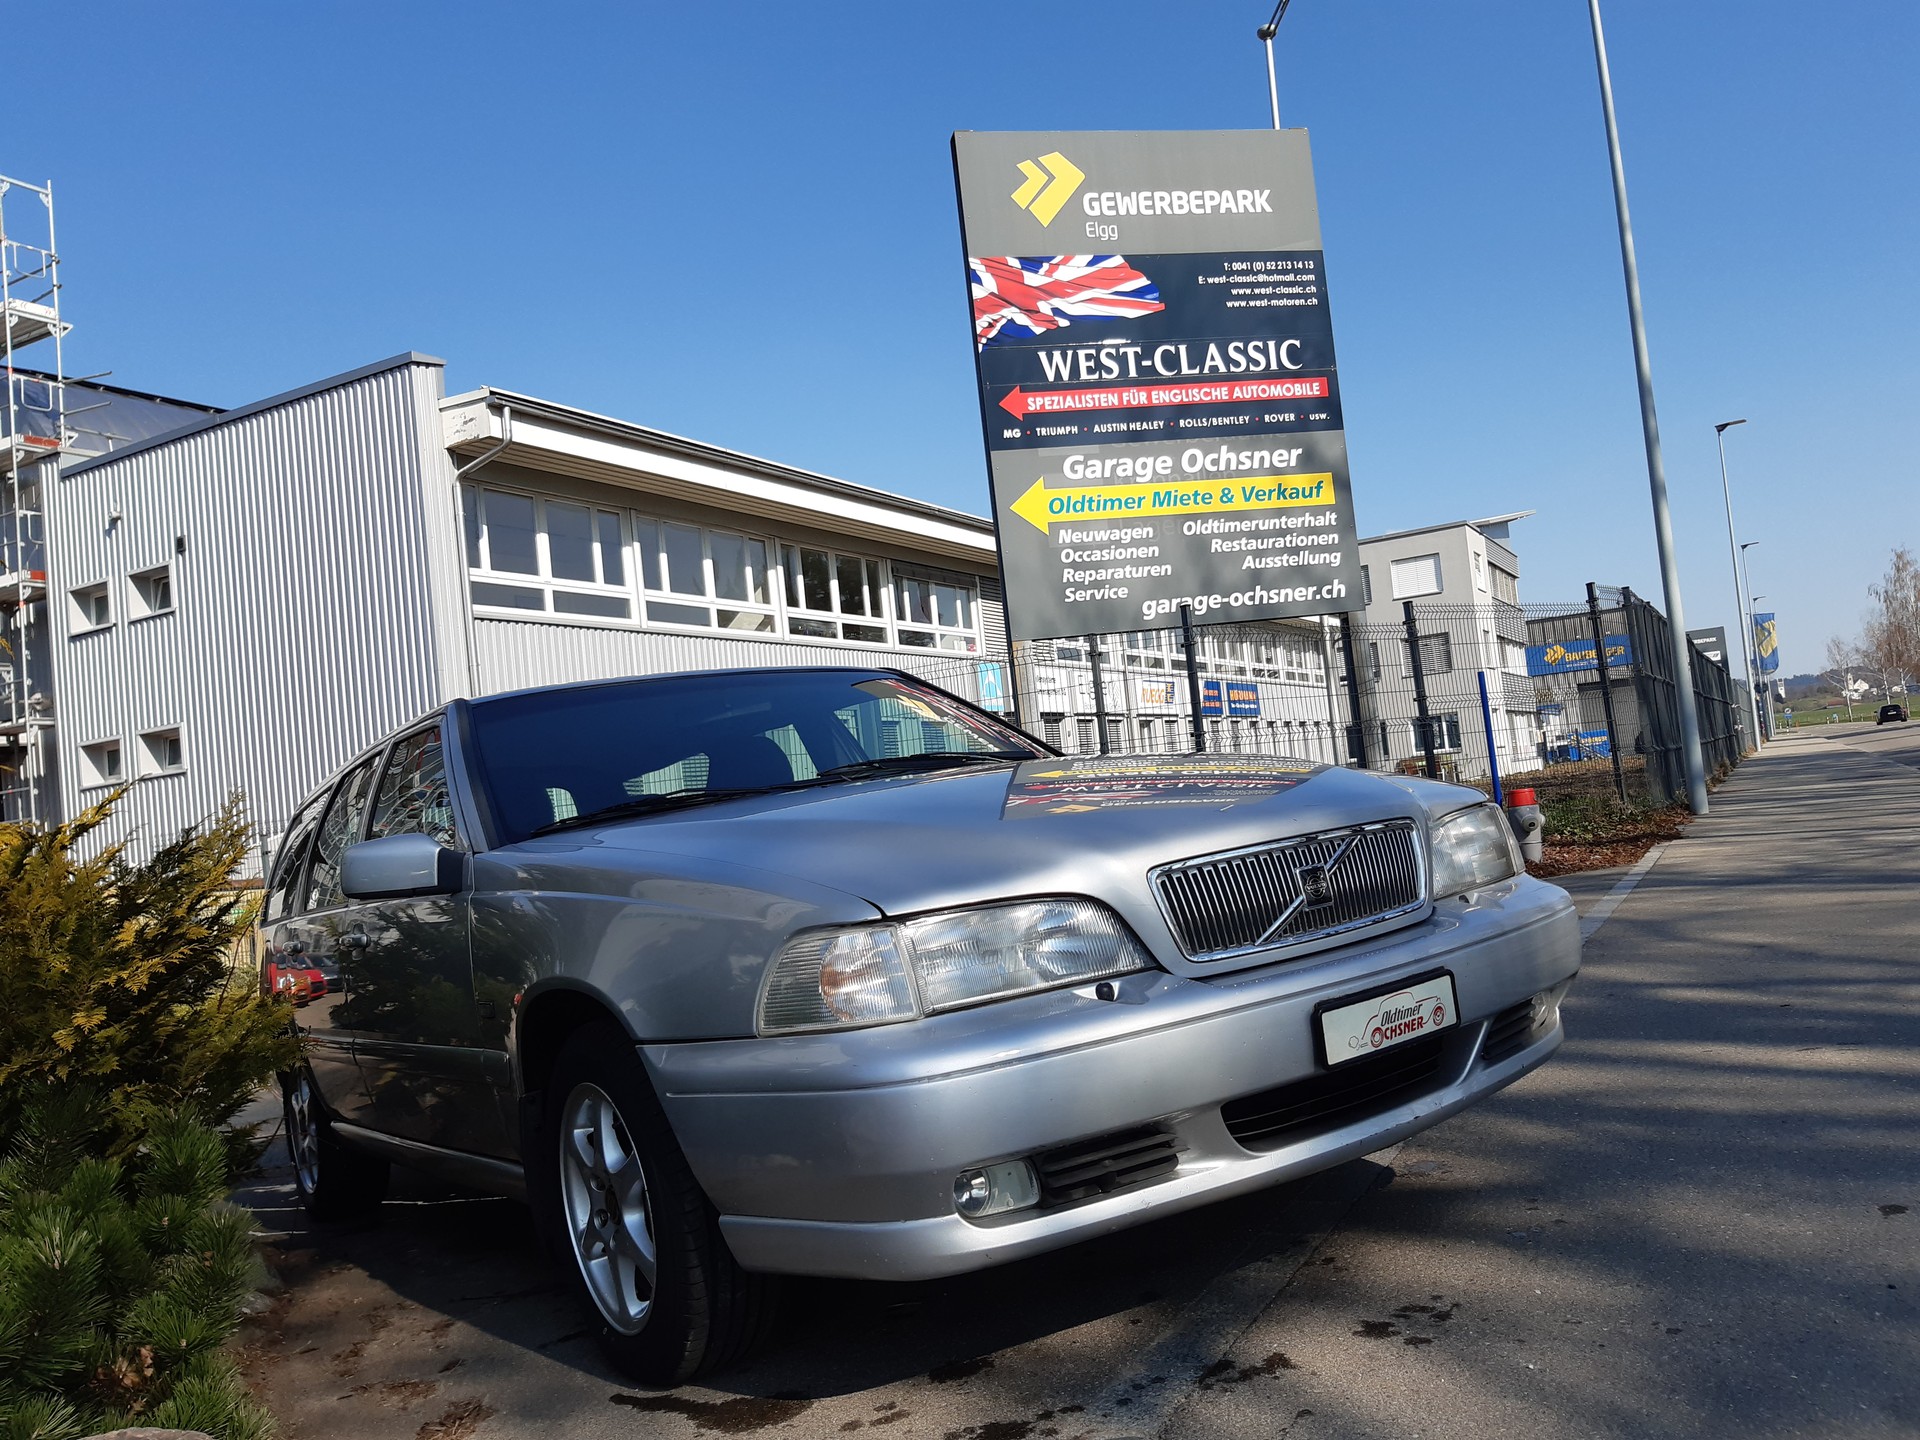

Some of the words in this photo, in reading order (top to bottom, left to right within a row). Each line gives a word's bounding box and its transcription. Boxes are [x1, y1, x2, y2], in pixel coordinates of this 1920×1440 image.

[1083, 189, 1273, 216] GEWERBEPARK
[1085, 221, 1118, 241] Elgg
[1224, 262, 1231, 271] T:
[1232, 261, 1251, 271] 0041
[1253, 261, 1265, 272] (0)
[1266, 261, 1276, 270] 52
[1277, 261, 1292, 270] 213
[1293, 260, 1303, 269] 14
[1305, 260, 1314, 269] 13
[1198, 275, 1206, 284] E:
[1207, 272, 1315, 284] west-classic@hotmail.com
[1231, 284, 1317, 295] www.west-classic.ch
[1226, 296, 1318, 308] www.west-motoren.ch
[1037, 339, 1304, 382] WEST-CLASSIC
[1027, 393, 1119, 411] SPEZIALISTEN
[1122, 388, 1148, 405] FÜR
[1152, 386, 1231, 404] ENGLISCHE
[1233, 382, 1320, 400] AUTOMOBILE
[1003, 429, 1021, 438] MG
[1036, 426, 1078, 436] TRIUMPH
[1093, 422, 1127, 433] AUSTIN
[1129, 420, 1164, 430] HEALEY
[1179, 415, 1250, 428] ROLLS/BENTLEY
[1264, 413, 1295, 423] ROVER
[1062, 454, 1173, 483] Garage
[1181, 445, 1303, 473] Ochsner
[1048, 493, 1145, 515] Oldtimer
[1152, 489, 1213, 508] Miete
[1219, 487, 1235, 504] &
[1241, 480, 1324, 502] Verkauf
[1058, 525, 1154, 545] Neuwagen
[1182, 511, 1337, 537] Oldtimerunterhalt
[1060, 544, 1159, 564] Occasionen
[1210, 532, 1339, 554] Restaurationen
[1242, 549, 1341, 571] Ausstellung
[1062, 563, 1172, 585] Reparaturen
[1064, 584, 1129, 603] Service
[1142, 578, 1346, 621] garage-ochsner.ch
[1380, 1003, 1424, 1027] Oldtimer
[1370, 1015, 1425, 1048] OCHSNER
